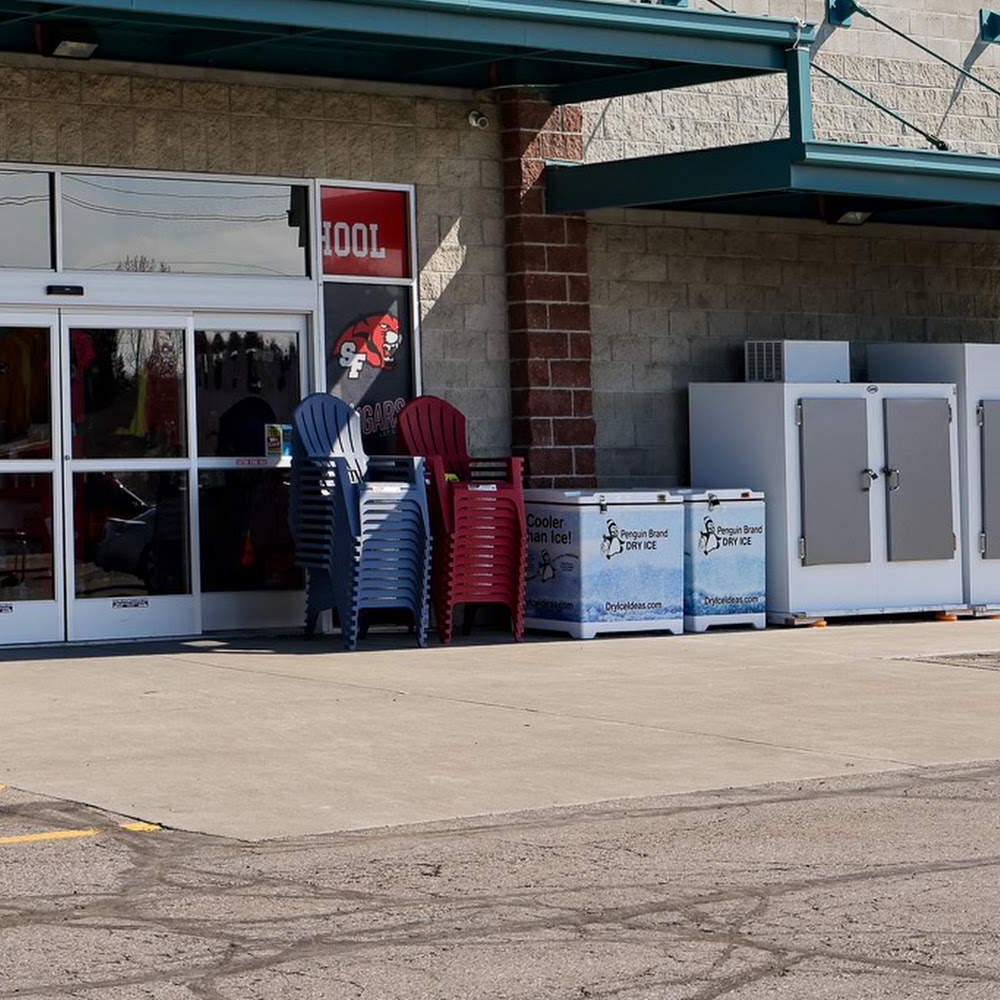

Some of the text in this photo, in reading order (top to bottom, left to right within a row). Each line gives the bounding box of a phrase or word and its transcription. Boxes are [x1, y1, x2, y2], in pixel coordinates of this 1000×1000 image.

[526, 513, 564, 529] Cooler
[620, 528, 668, 540] Penguin Brand
[717, 524, 763, 536] Penguin Brand
[551, 530, 572, 545] Ice!
[722, 536, 752, 546] DRY ICE
[625, 540, 657, 550] DRY ICE
